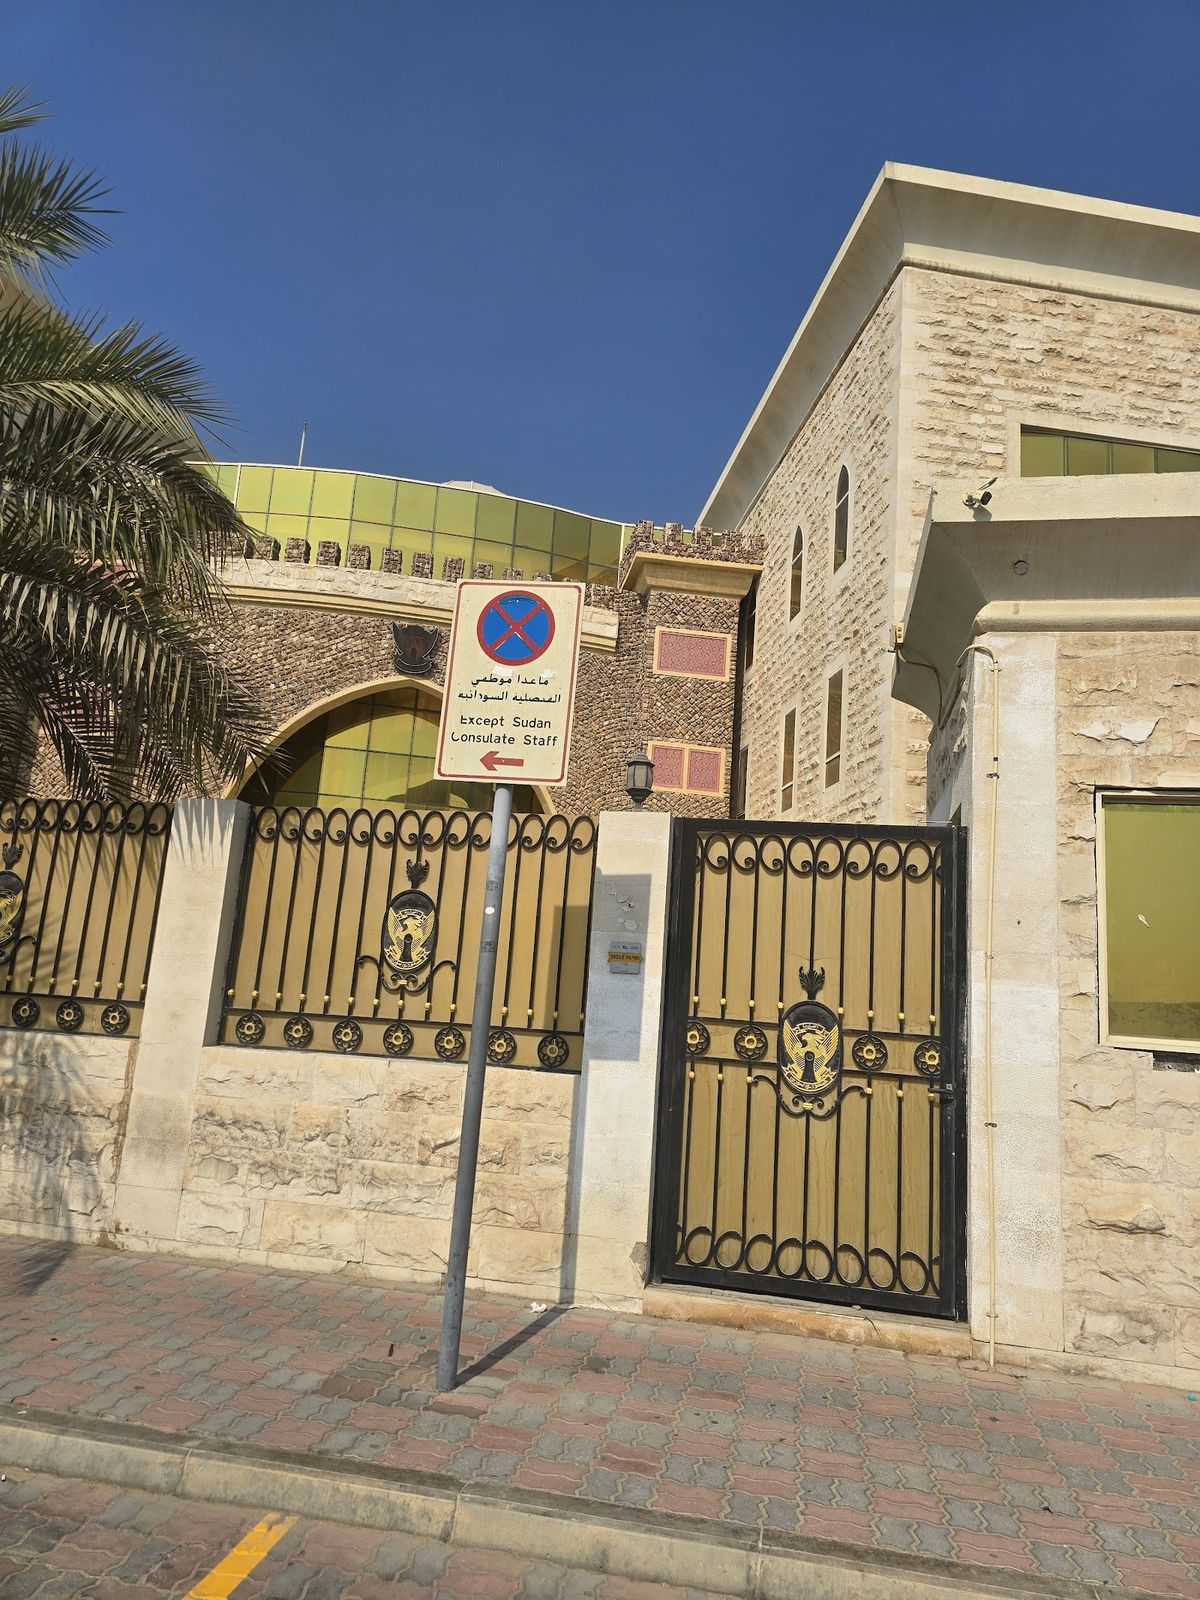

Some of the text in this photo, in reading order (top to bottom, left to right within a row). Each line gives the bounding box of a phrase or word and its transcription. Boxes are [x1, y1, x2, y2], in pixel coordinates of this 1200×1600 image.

[460, 715, 551, 729] Except Sudan
[450, 731, 558, 747] Consulate Staff
